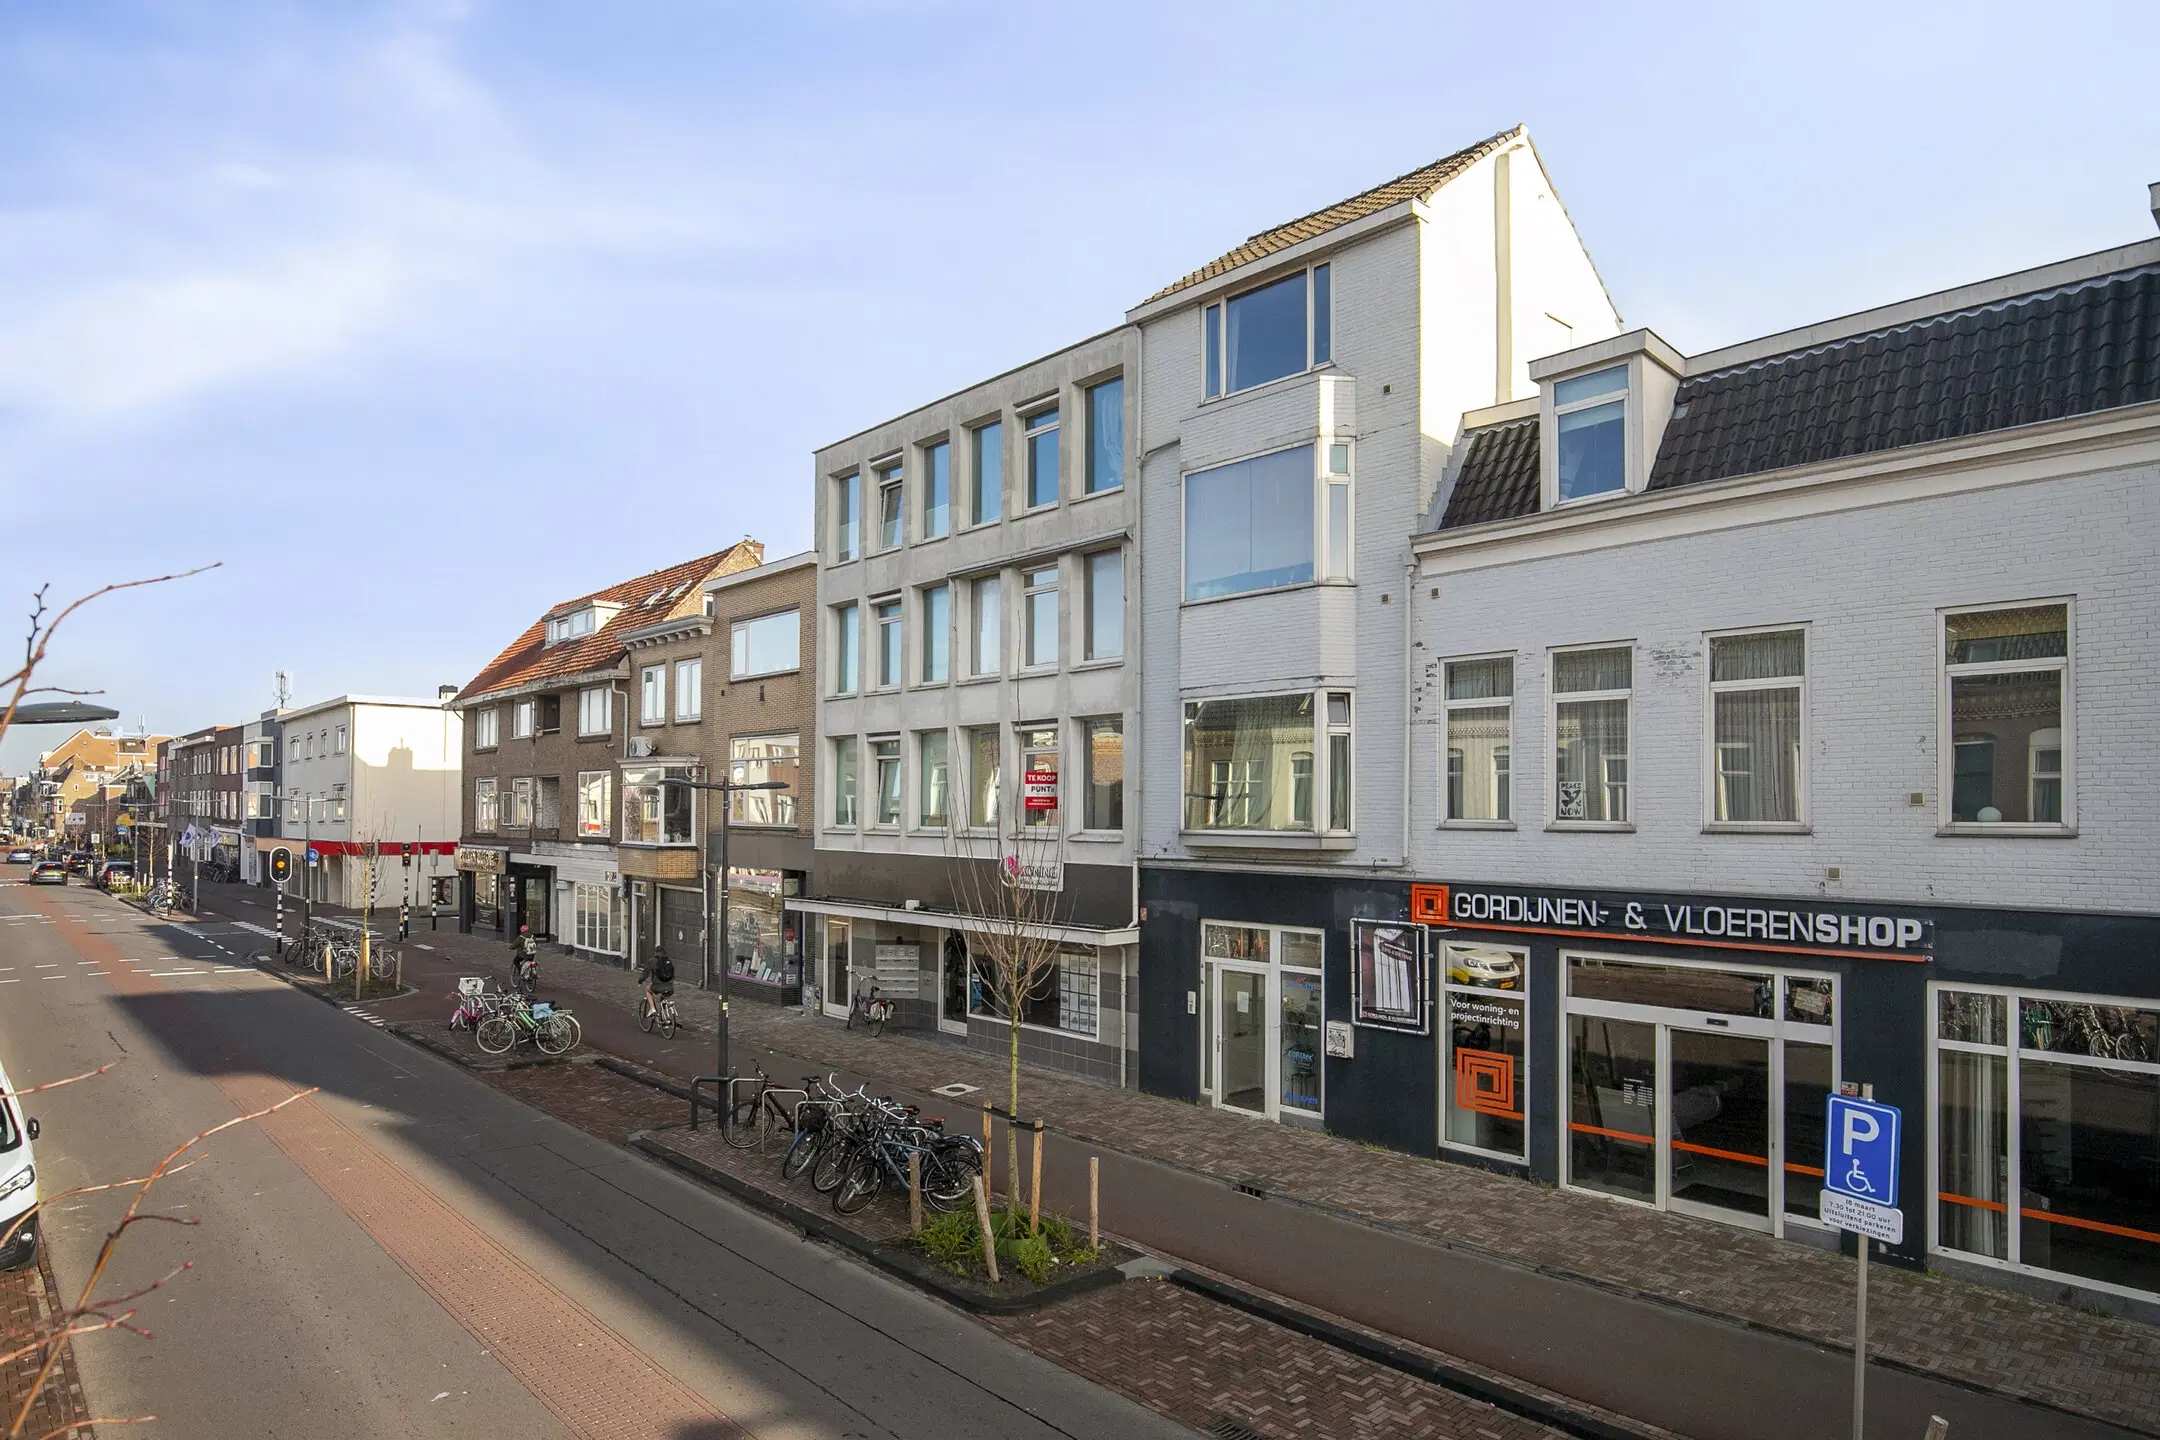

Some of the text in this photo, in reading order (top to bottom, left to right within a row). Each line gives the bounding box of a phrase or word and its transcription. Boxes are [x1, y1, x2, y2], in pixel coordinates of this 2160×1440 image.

[1454, 892, 1922, 948] GORDIJNEN- & VLOERENSHOP
[1450, 999, 1520, 1016] Voor woning- en
[1450, 1012, 1520, 1030] projectinrichting
[1843, 1108, 1880, 1156] P
[1846, 1206, 1856, 1214] tot
[1857, 1209, 1876, 1220] 21.00
[1878, 1216, 1891, 1224] uur
[1854, 1203, 1876, 1212] maart
[1824, 1208, 1896, 1233] Uitsluitend parkeren
[1844, 1221, 1890, 1238] verkiezingen
